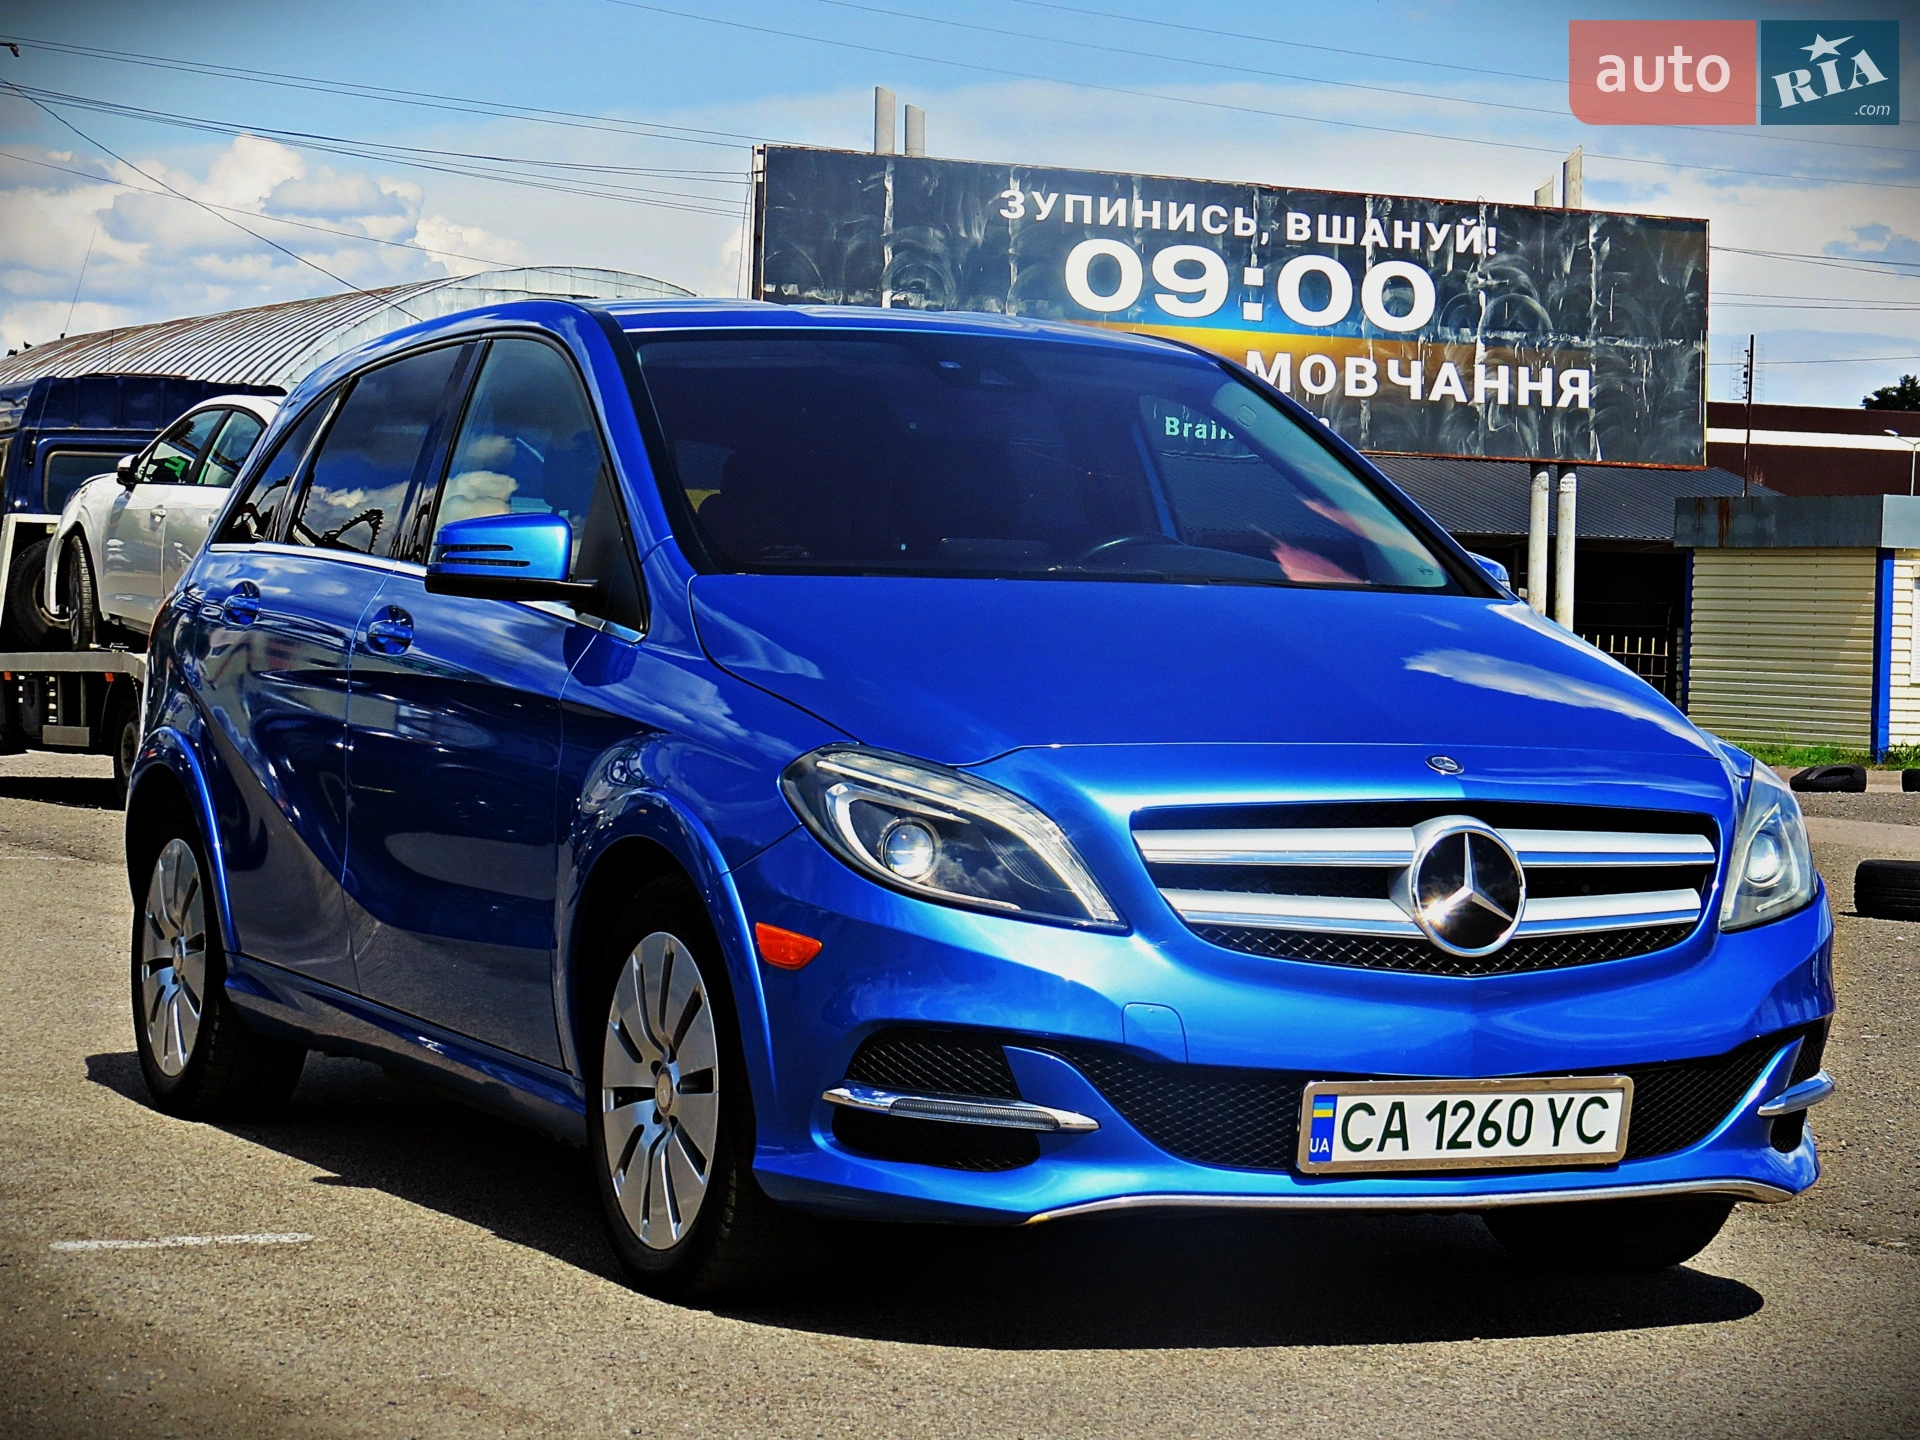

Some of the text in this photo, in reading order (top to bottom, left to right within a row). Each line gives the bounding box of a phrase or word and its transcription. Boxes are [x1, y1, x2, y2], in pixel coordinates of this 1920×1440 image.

[1000, 189, 1496, 256] ЗУПИНИСЬ, ВШАНУЙ!
[1064, 238, 1435, 332] 09:00
[1245, 350, 1589, 408] МОВЧАННЯ
[1310, 1137, 1330, 1154] UA
[1341, 1096, 1609, 1152] CA 1260 YC
